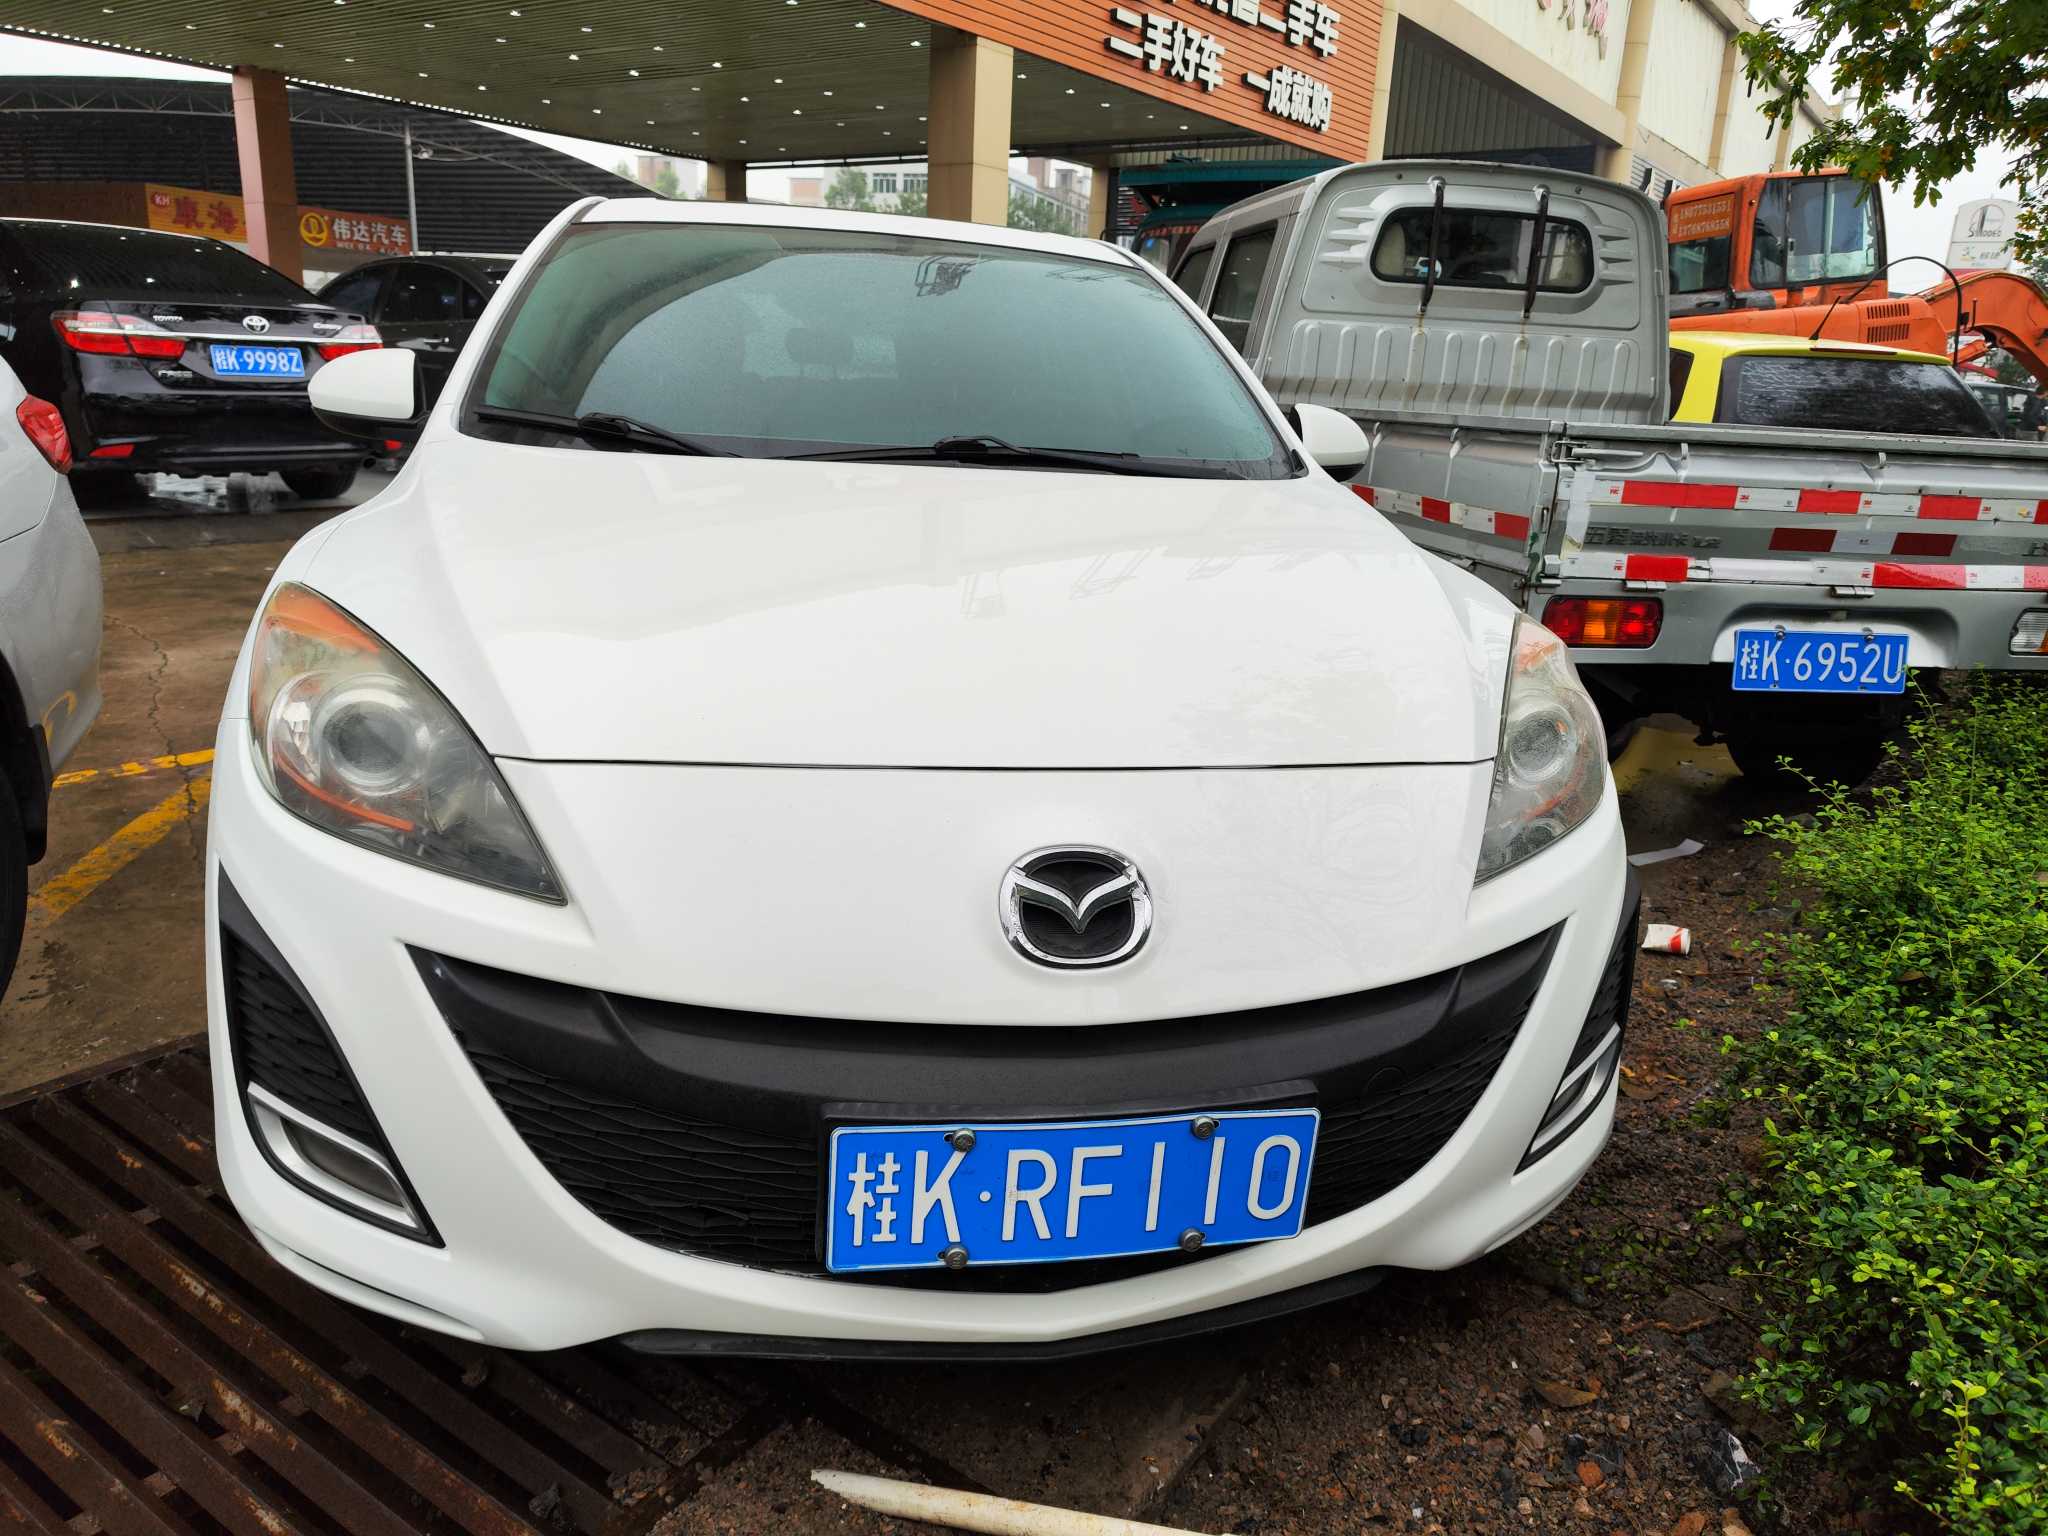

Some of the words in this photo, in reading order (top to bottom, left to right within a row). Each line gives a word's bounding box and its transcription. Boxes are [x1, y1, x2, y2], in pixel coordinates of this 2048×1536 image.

[1110, 8, 1226, 92] 二手好车
[1247, 65, 1333, 133] 一成就购
[333, 218, 408, 246] 伟达汽车
[152, 315, 184, 323] TOYOTA
